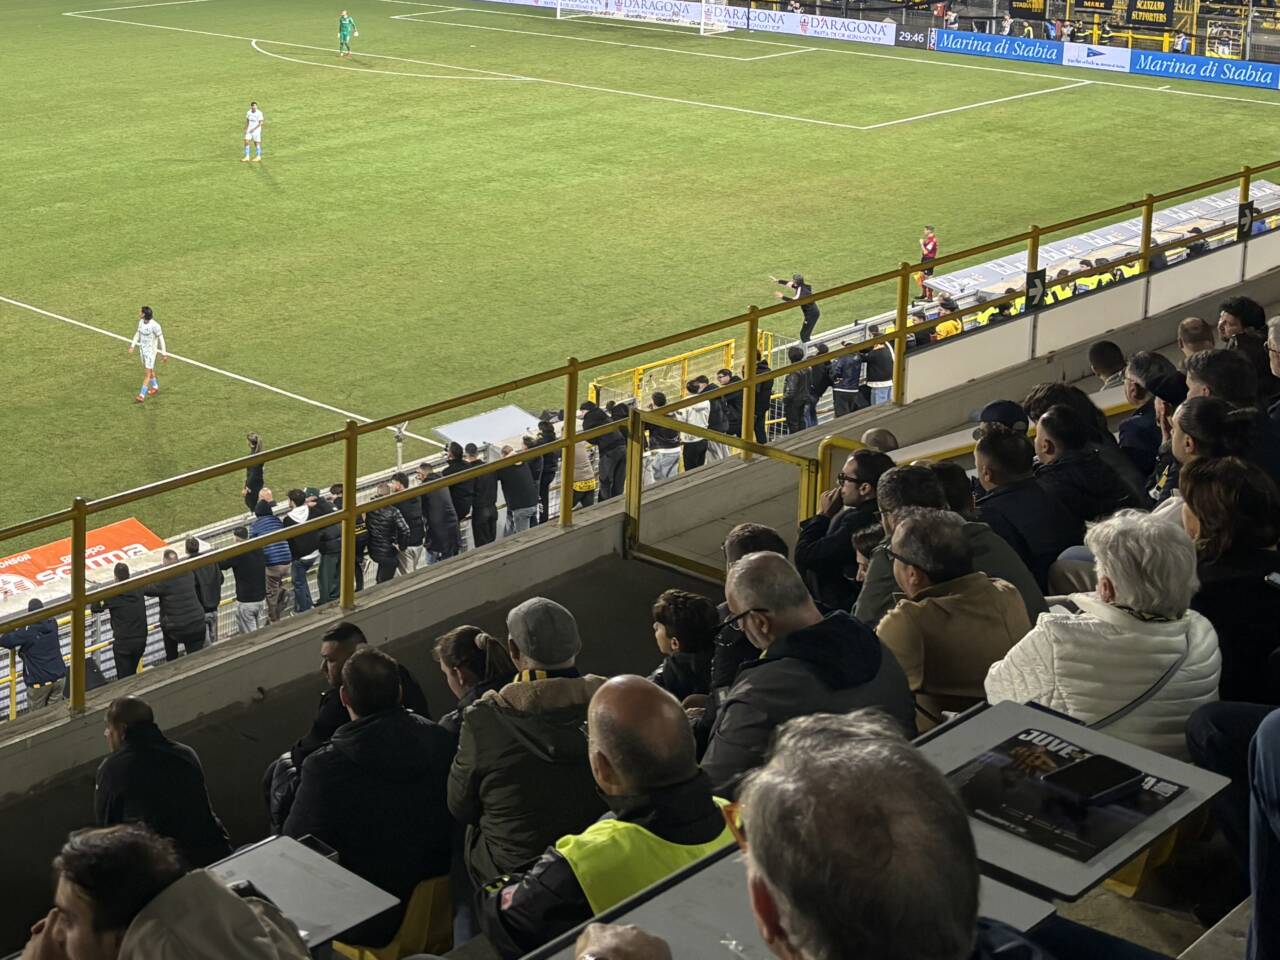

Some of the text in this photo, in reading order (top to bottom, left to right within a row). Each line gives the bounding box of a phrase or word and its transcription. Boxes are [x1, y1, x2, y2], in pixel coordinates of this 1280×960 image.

[714, 5, 785, 24] D'ARAGONA
[1131, 11, 1167, 22] SUPPORTERS
[810, 16, 887, 37] D'ARAGONA
[899, 31, 925, 43] 29:46
[940, 33, 991, 54] Marina
[994, 39, 1010, 54] di
[1012, 40, 1057, 59] Stabia
[1136, 54, 1197, 75] Marina
[1200, 60, 1219, 77] di
[1221, 63, 1273, 84] Stabia
[1018, 729, 1080, 760] JUVE
